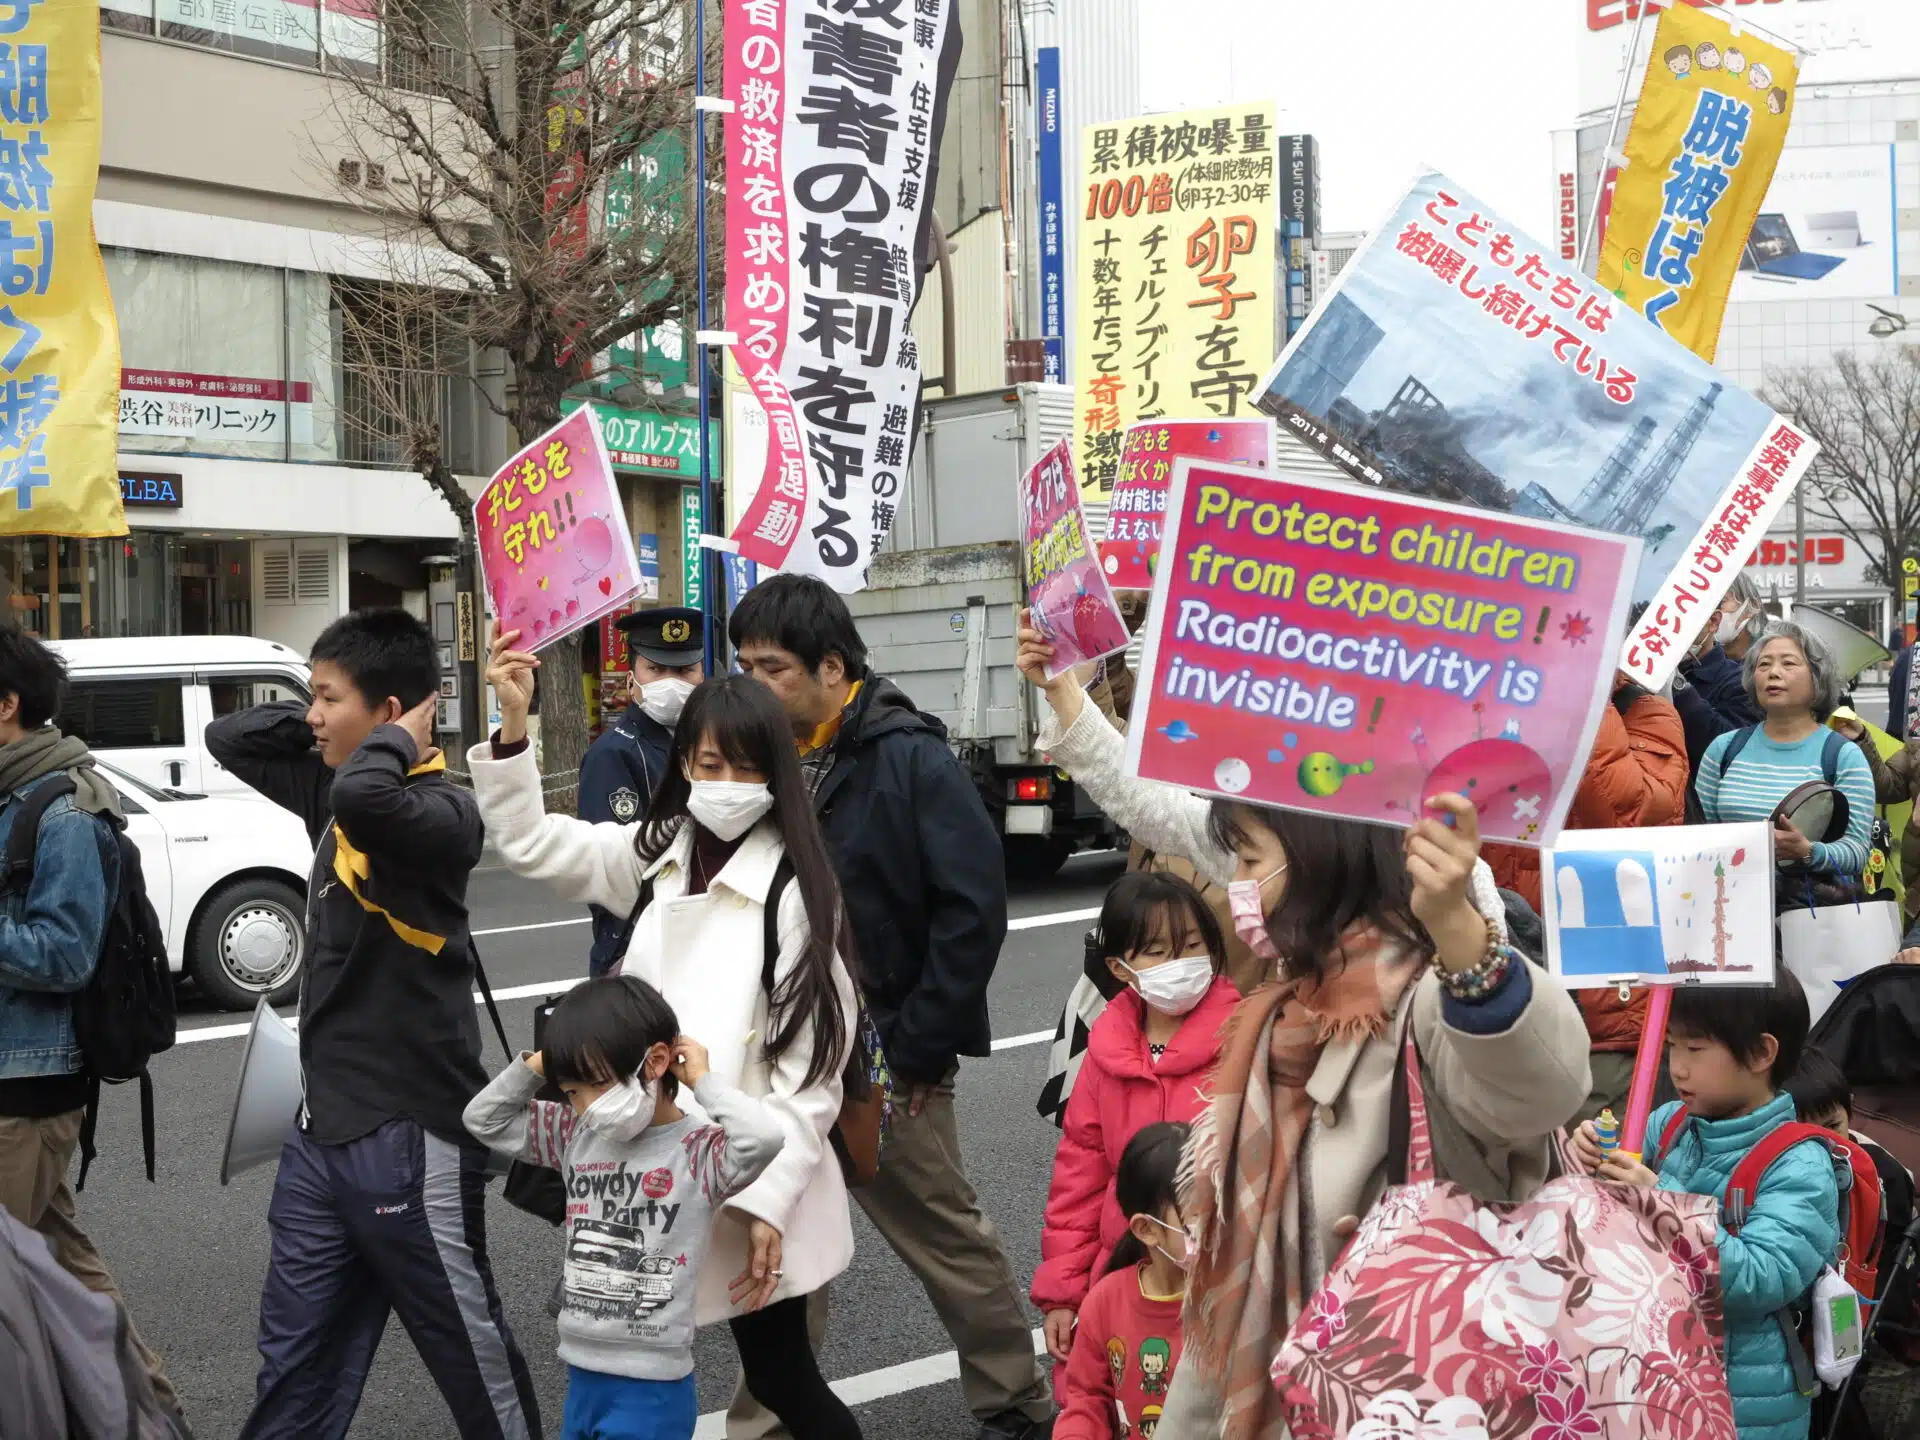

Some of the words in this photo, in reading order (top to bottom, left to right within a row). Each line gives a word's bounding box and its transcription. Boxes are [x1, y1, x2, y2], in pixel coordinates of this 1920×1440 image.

[1045, 88, 1056, 132] MIZUHO
[1089, 113, 1272, 174] 累積被曝量
[1293, 135, 1303, 157] THE
[1293, 160, 1304, 188] SUIT
[1644, 91, 1750, 328] 脱被ばく
[1425, 190, 1613, 333] こどもたちは
[1396, 222, 1637, 403] 被曝し続けている
[1289, 413, 1328, 444] 2011年
[487, 440, 572, 528] 子どもを
[1196, 485, 1381, 555] Protect
[1391, 524, 1575, 590] children
[1628, 424, 1806, 676] 原発事故は終わっていない
[1188, 545, 1296, 599] from
[1306, 573, 1522, 639] exposure
[1176, 599, 1491, 697] Radioactivity
[1500, 660, 1539, 703] is
[1166, 657, 1355, 728] invisible
[566, 1161, 644, 1207] Rowdy
[602, 1199, 681, 1235] Party
